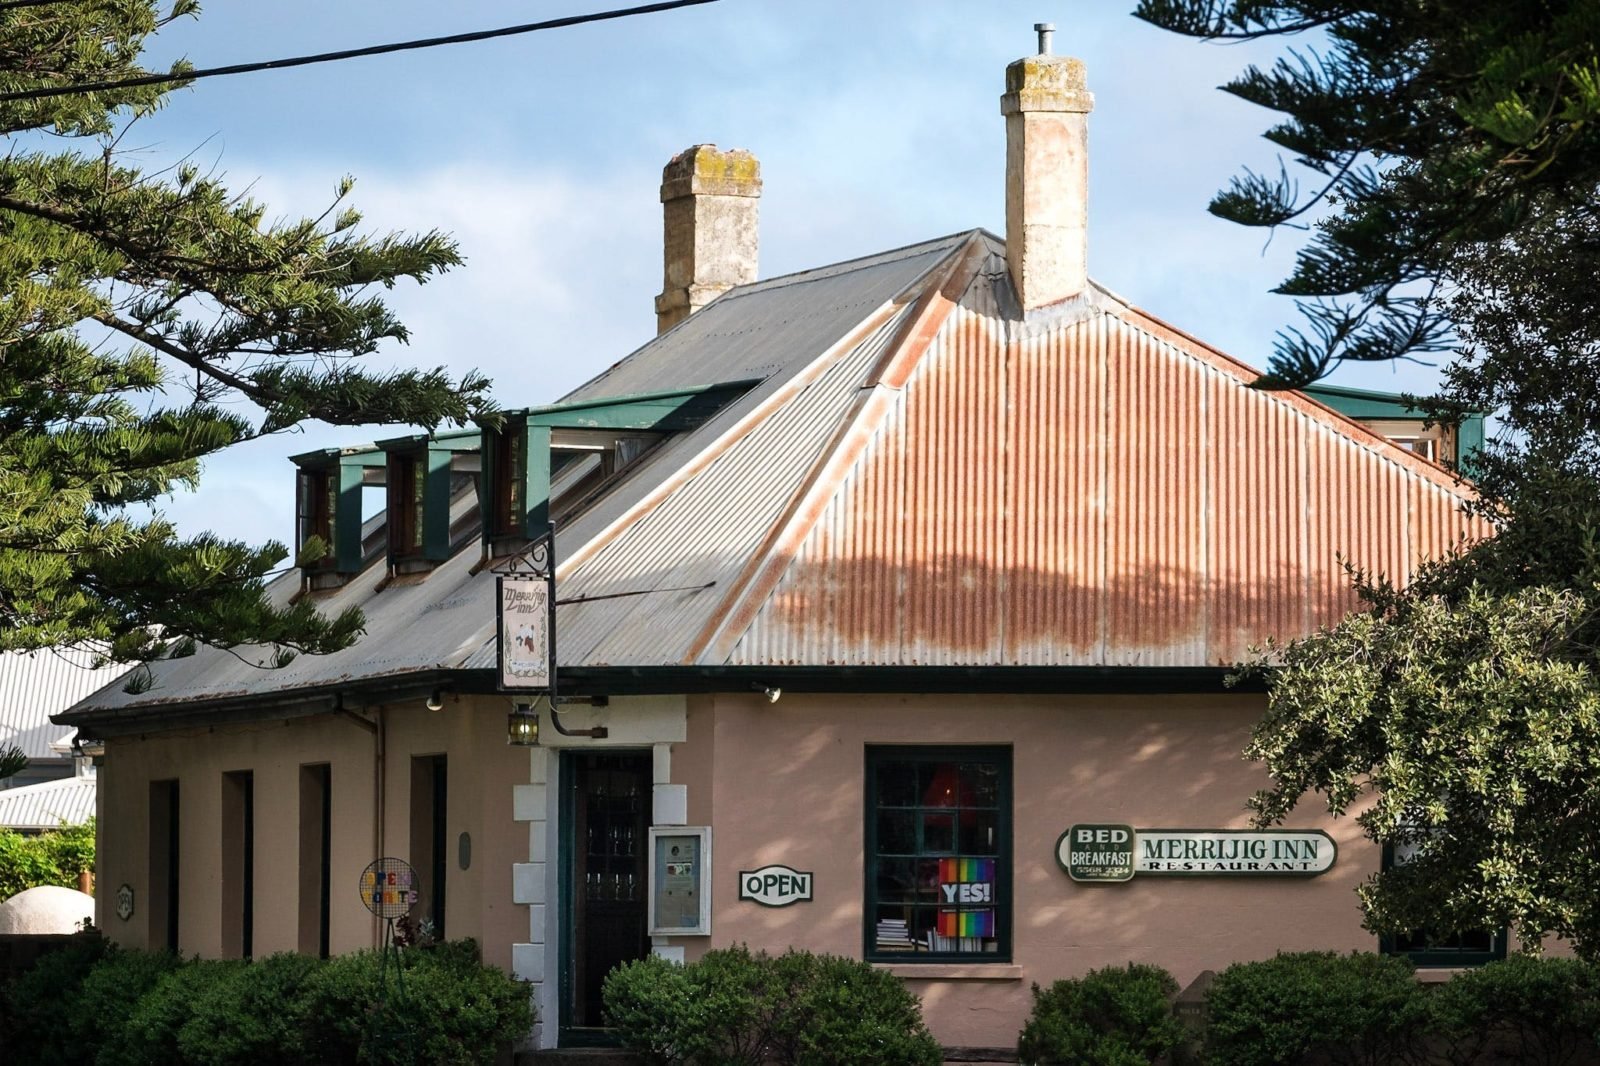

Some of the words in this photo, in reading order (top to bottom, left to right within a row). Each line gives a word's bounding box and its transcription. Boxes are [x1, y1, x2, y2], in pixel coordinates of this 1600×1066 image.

[1077, 829, 1128, 843] BED
[1071, 852, 1132, 865] BREAKFAST
[1142, 839, 1268, 859] MERRIJIG
[1272, 839, 1320, 859] INN
[746, 874, 806, 897] OPEN
[941, 882, 991, 903] YES!
